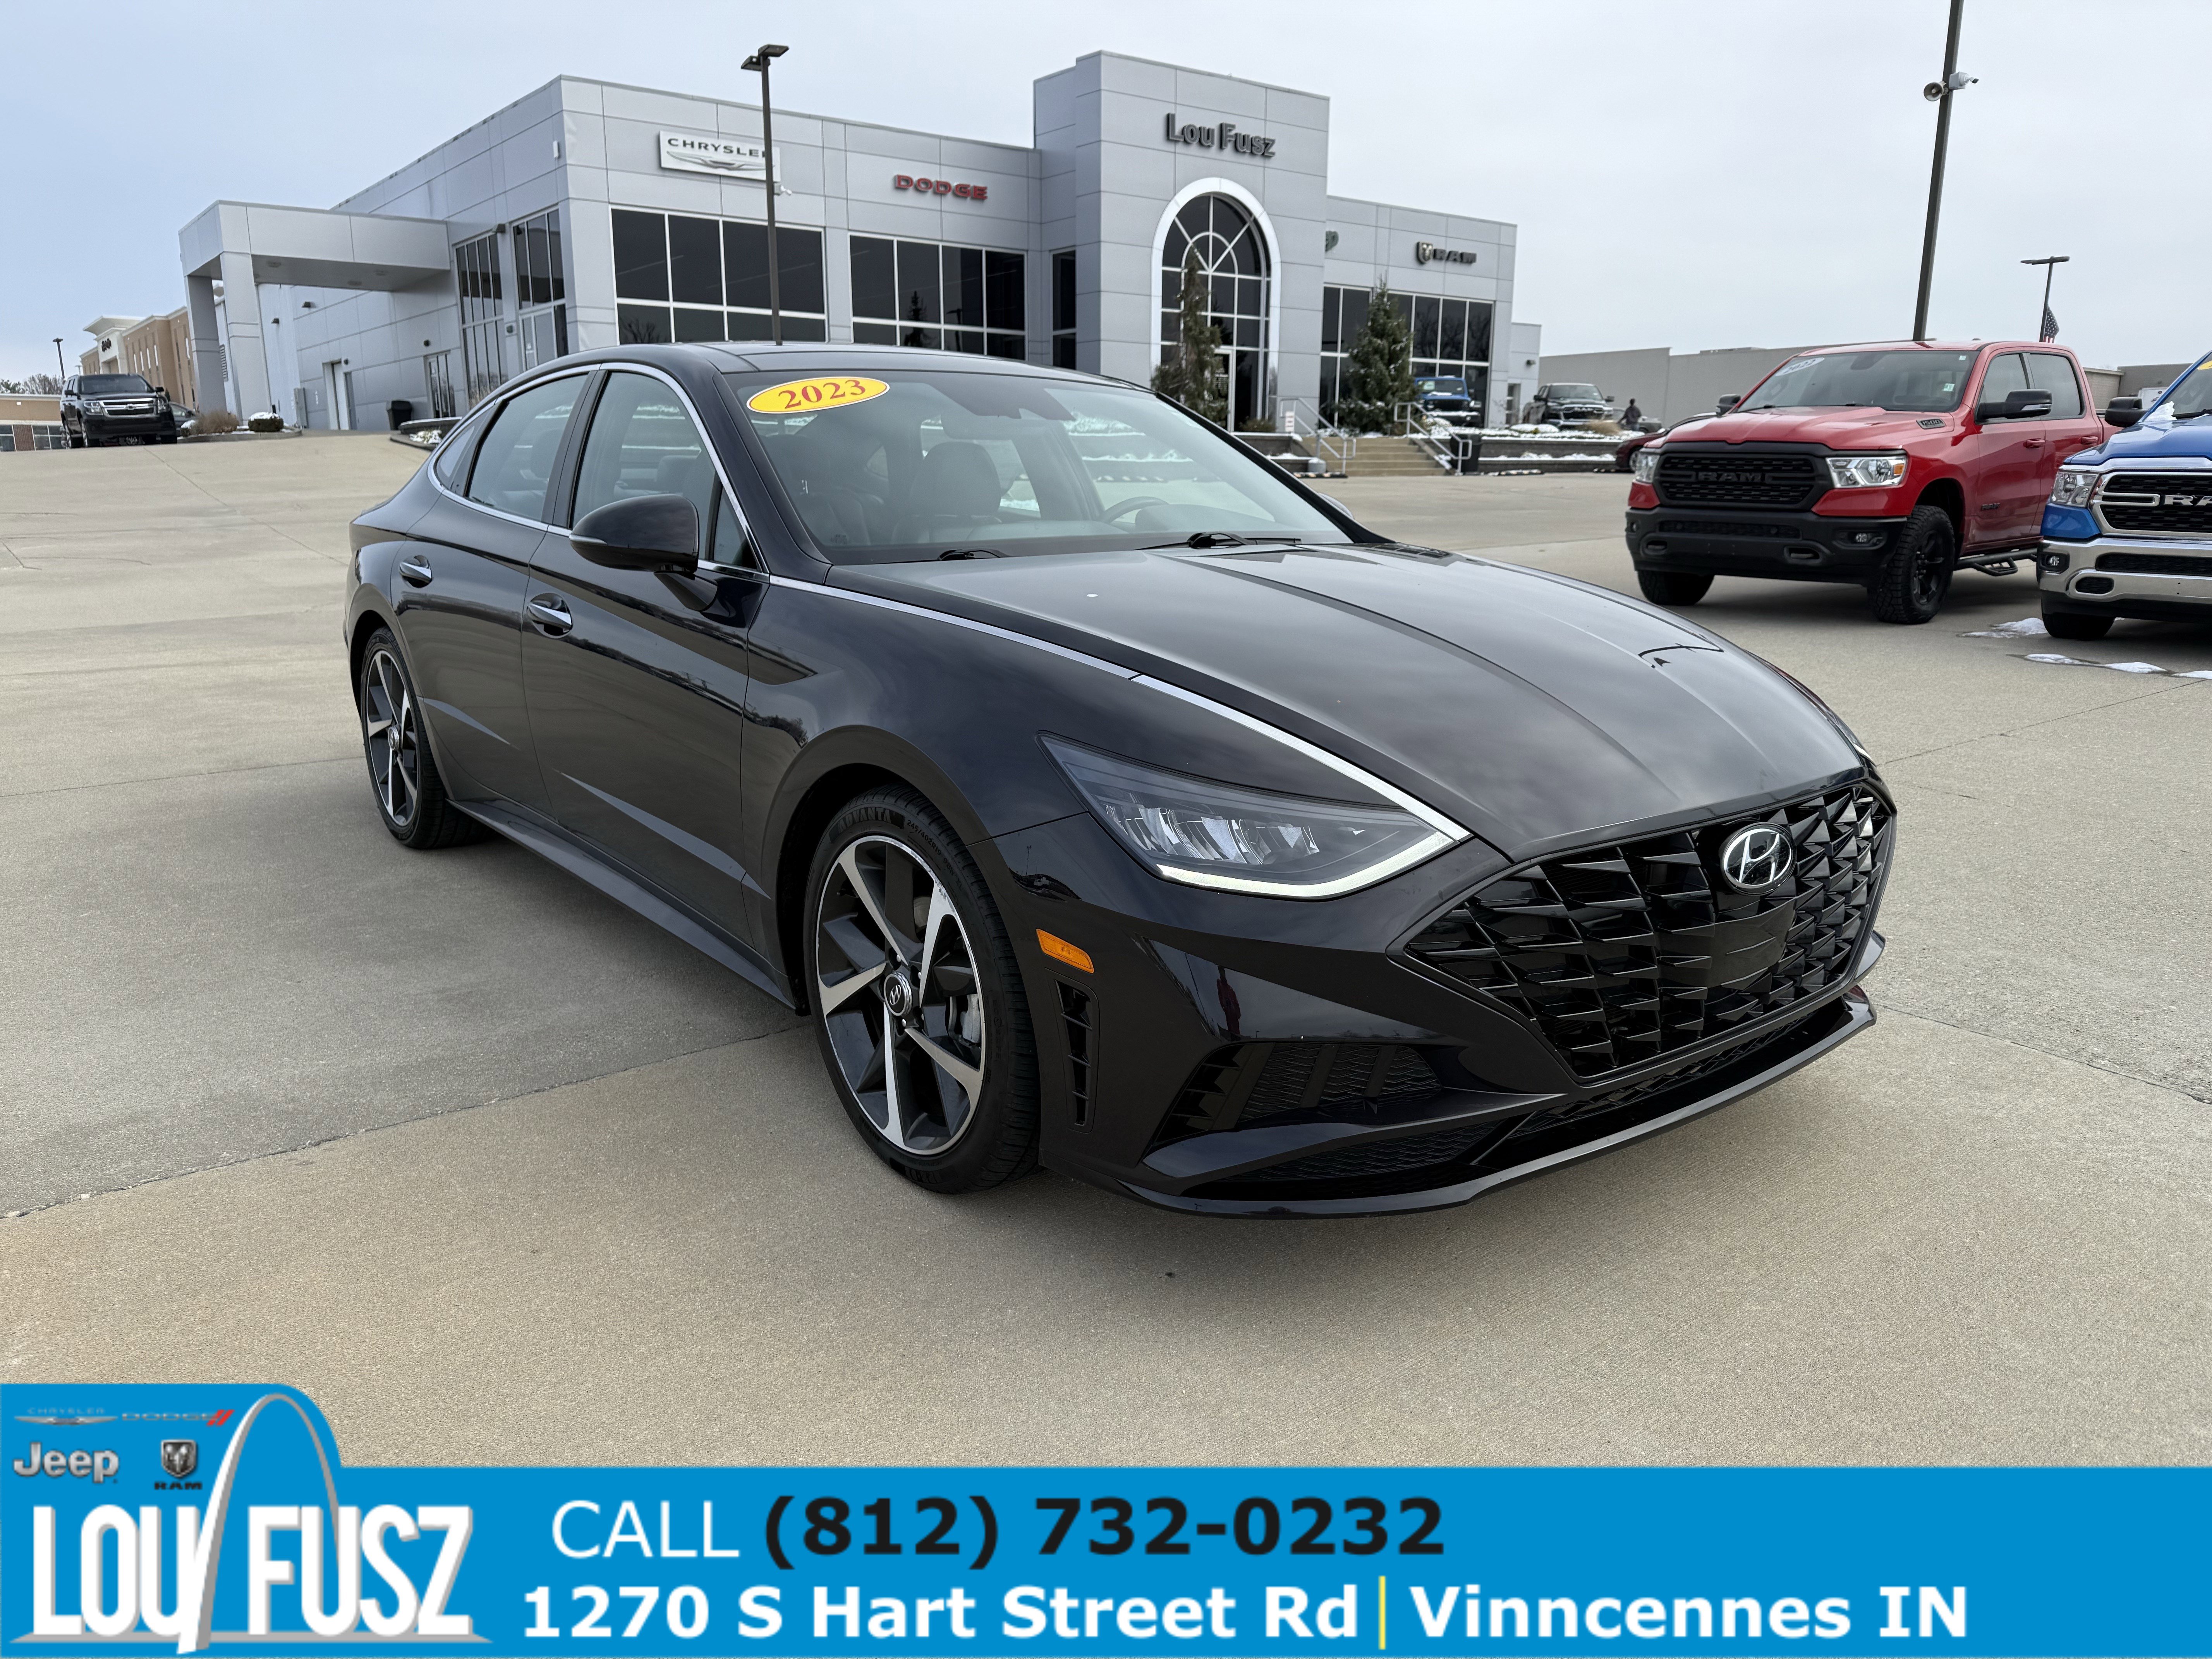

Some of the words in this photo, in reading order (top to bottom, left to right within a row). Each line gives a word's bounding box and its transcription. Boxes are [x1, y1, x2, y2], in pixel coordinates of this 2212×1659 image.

[667, 138, 766, 158] CHRYSLE
[1167, 113, 1215, 147] Lou
[1219, 122, 1276, 157] Fusz
[894, 174, 988, 200] DODGE
[1433, 248, 1477, 264] RAM
[778, 379, 866, 409] 2023
[1698, 471, 1762, 483] RAM
[838, 807, 891, 834] ADVANTA
